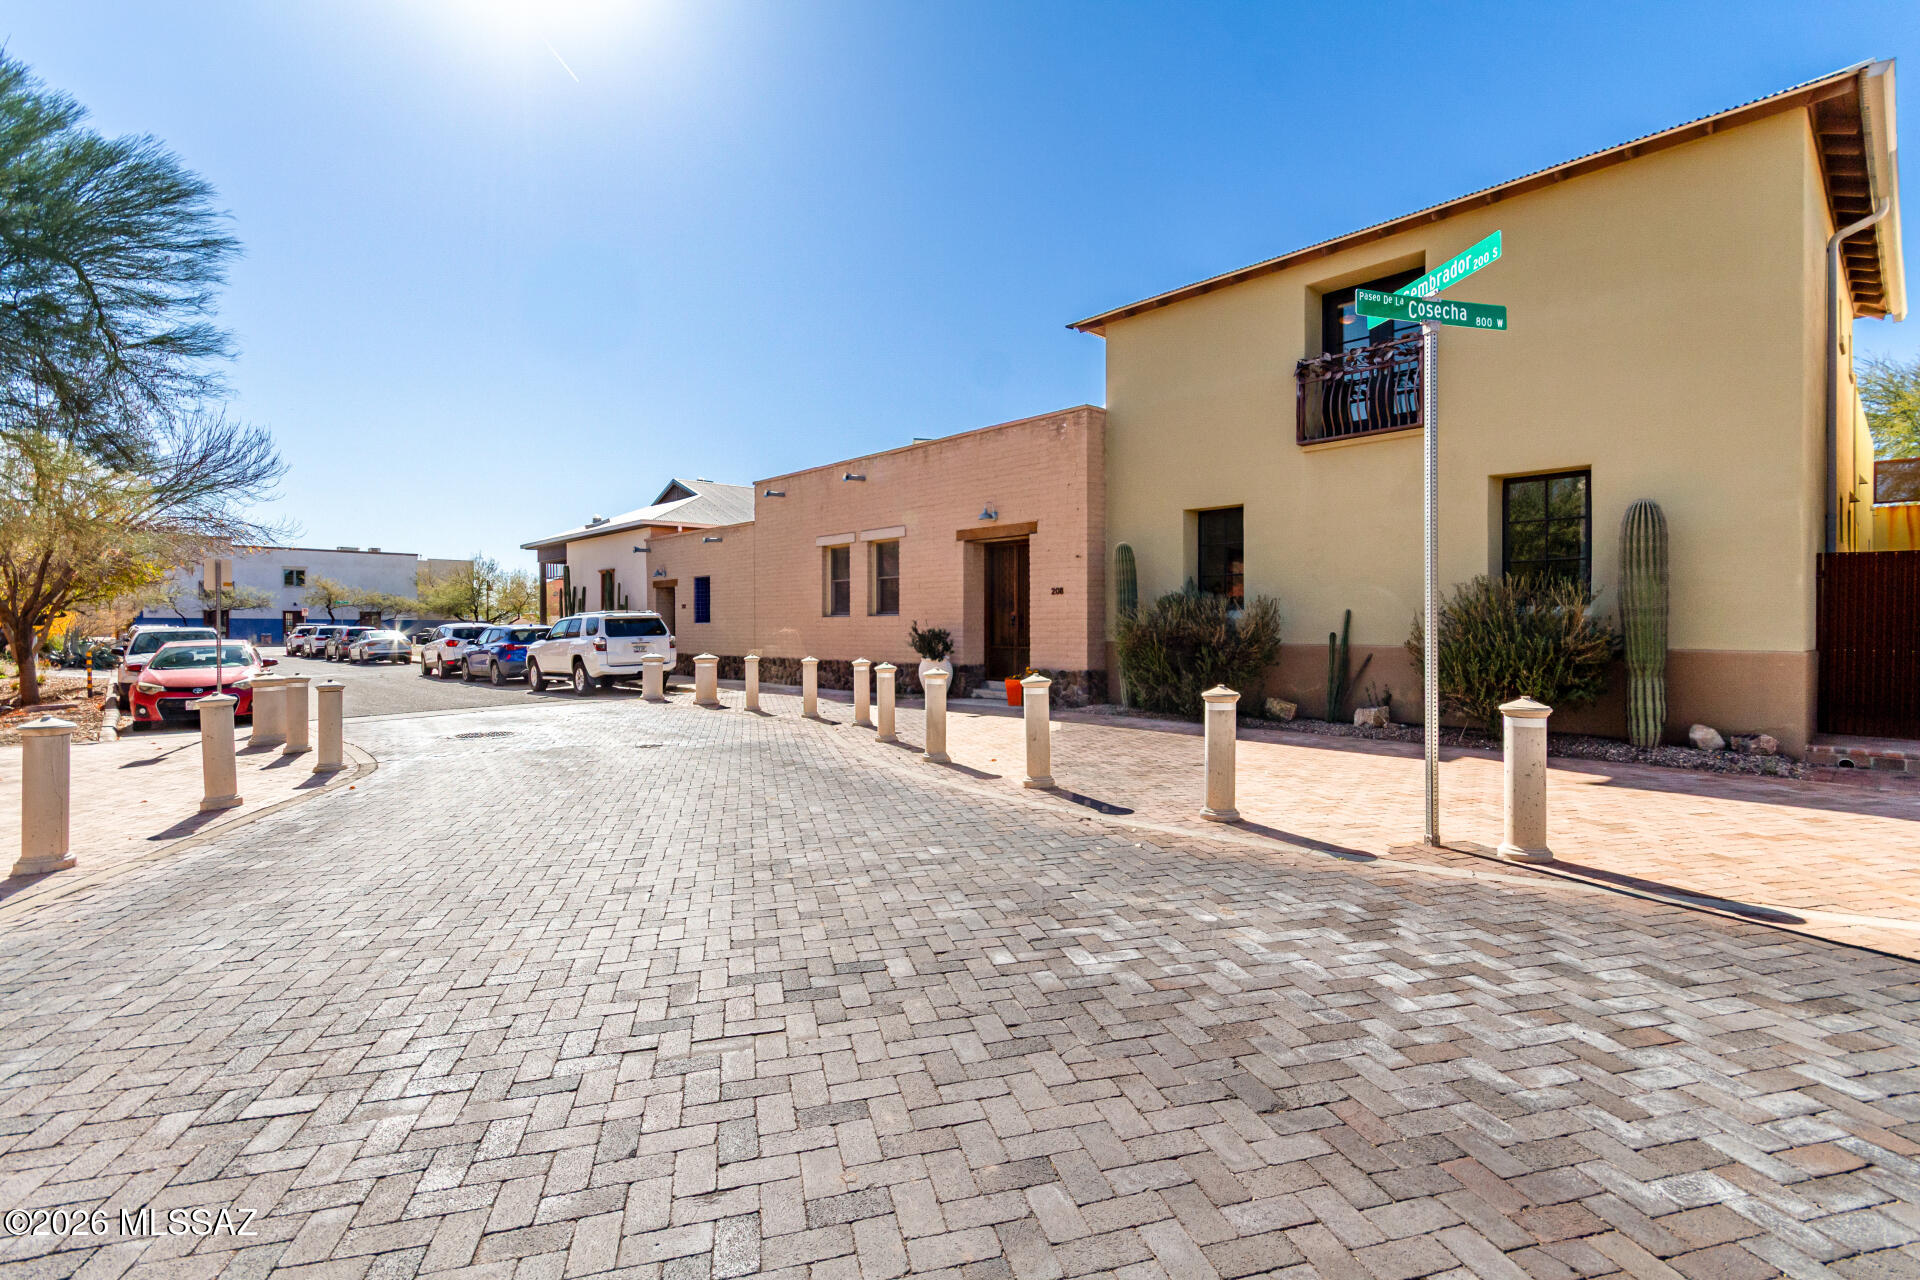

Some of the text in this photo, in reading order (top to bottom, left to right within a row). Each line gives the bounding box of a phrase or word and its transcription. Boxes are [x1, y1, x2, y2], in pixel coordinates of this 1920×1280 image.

[1473, 252, 1489, 270] 200
[1492, 246, 1498, 258] S
[1359, 291, 1504, 328] Paseo De La Cosecha 800 W
